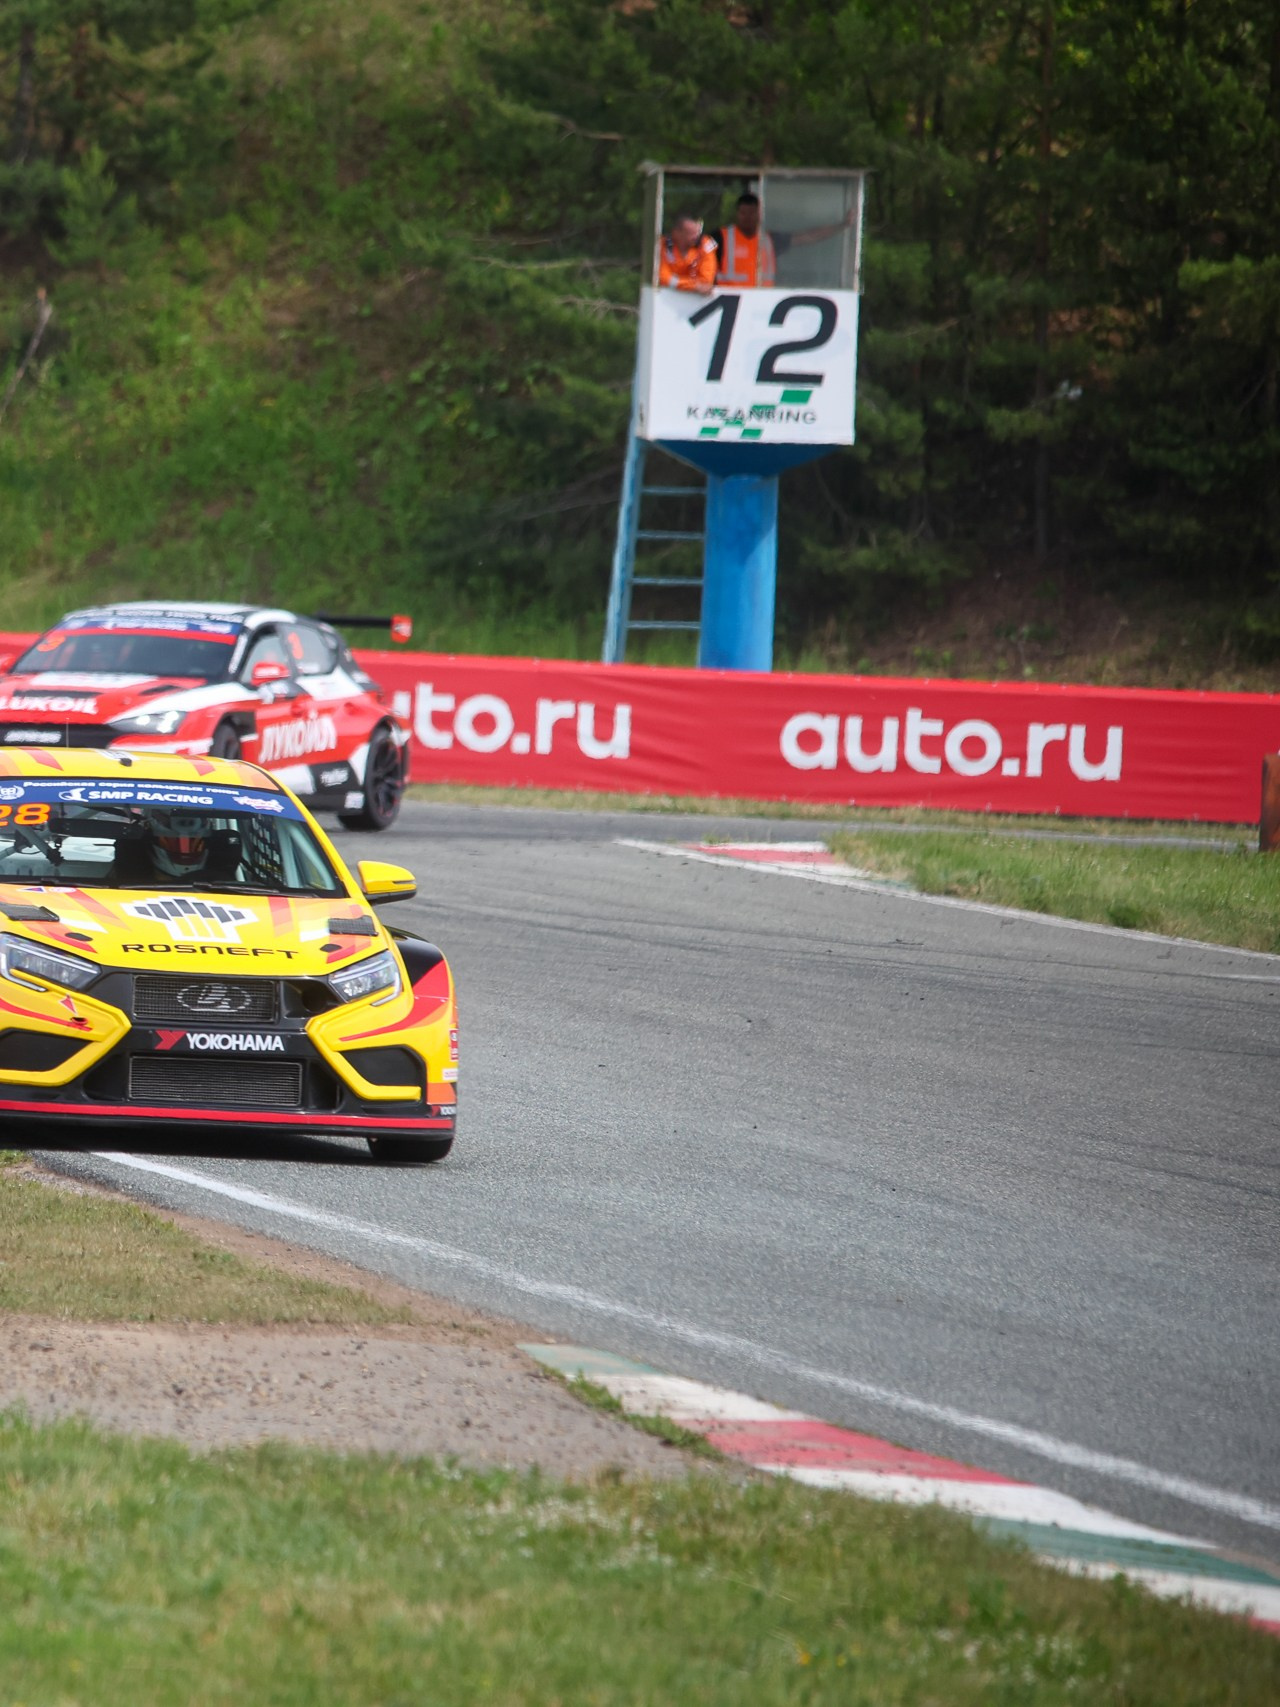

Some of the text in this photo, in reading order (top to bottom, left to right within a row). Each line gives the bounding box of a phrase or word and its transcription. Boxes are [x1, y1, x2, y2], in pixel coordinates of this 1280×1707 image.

[688, 294, 838, 385] 12
[258, 709, 338, 764] ЛУКОЙЛ
[393, 682, 632, 759] to.ru
[780, 707, 1123, 782] auto.ru
[88, 790, 214, 805] SMP RACING
[121, 943, 298, 959] ROSNEFT
[186, 1032, 285, 1051] YOKOHAMA
